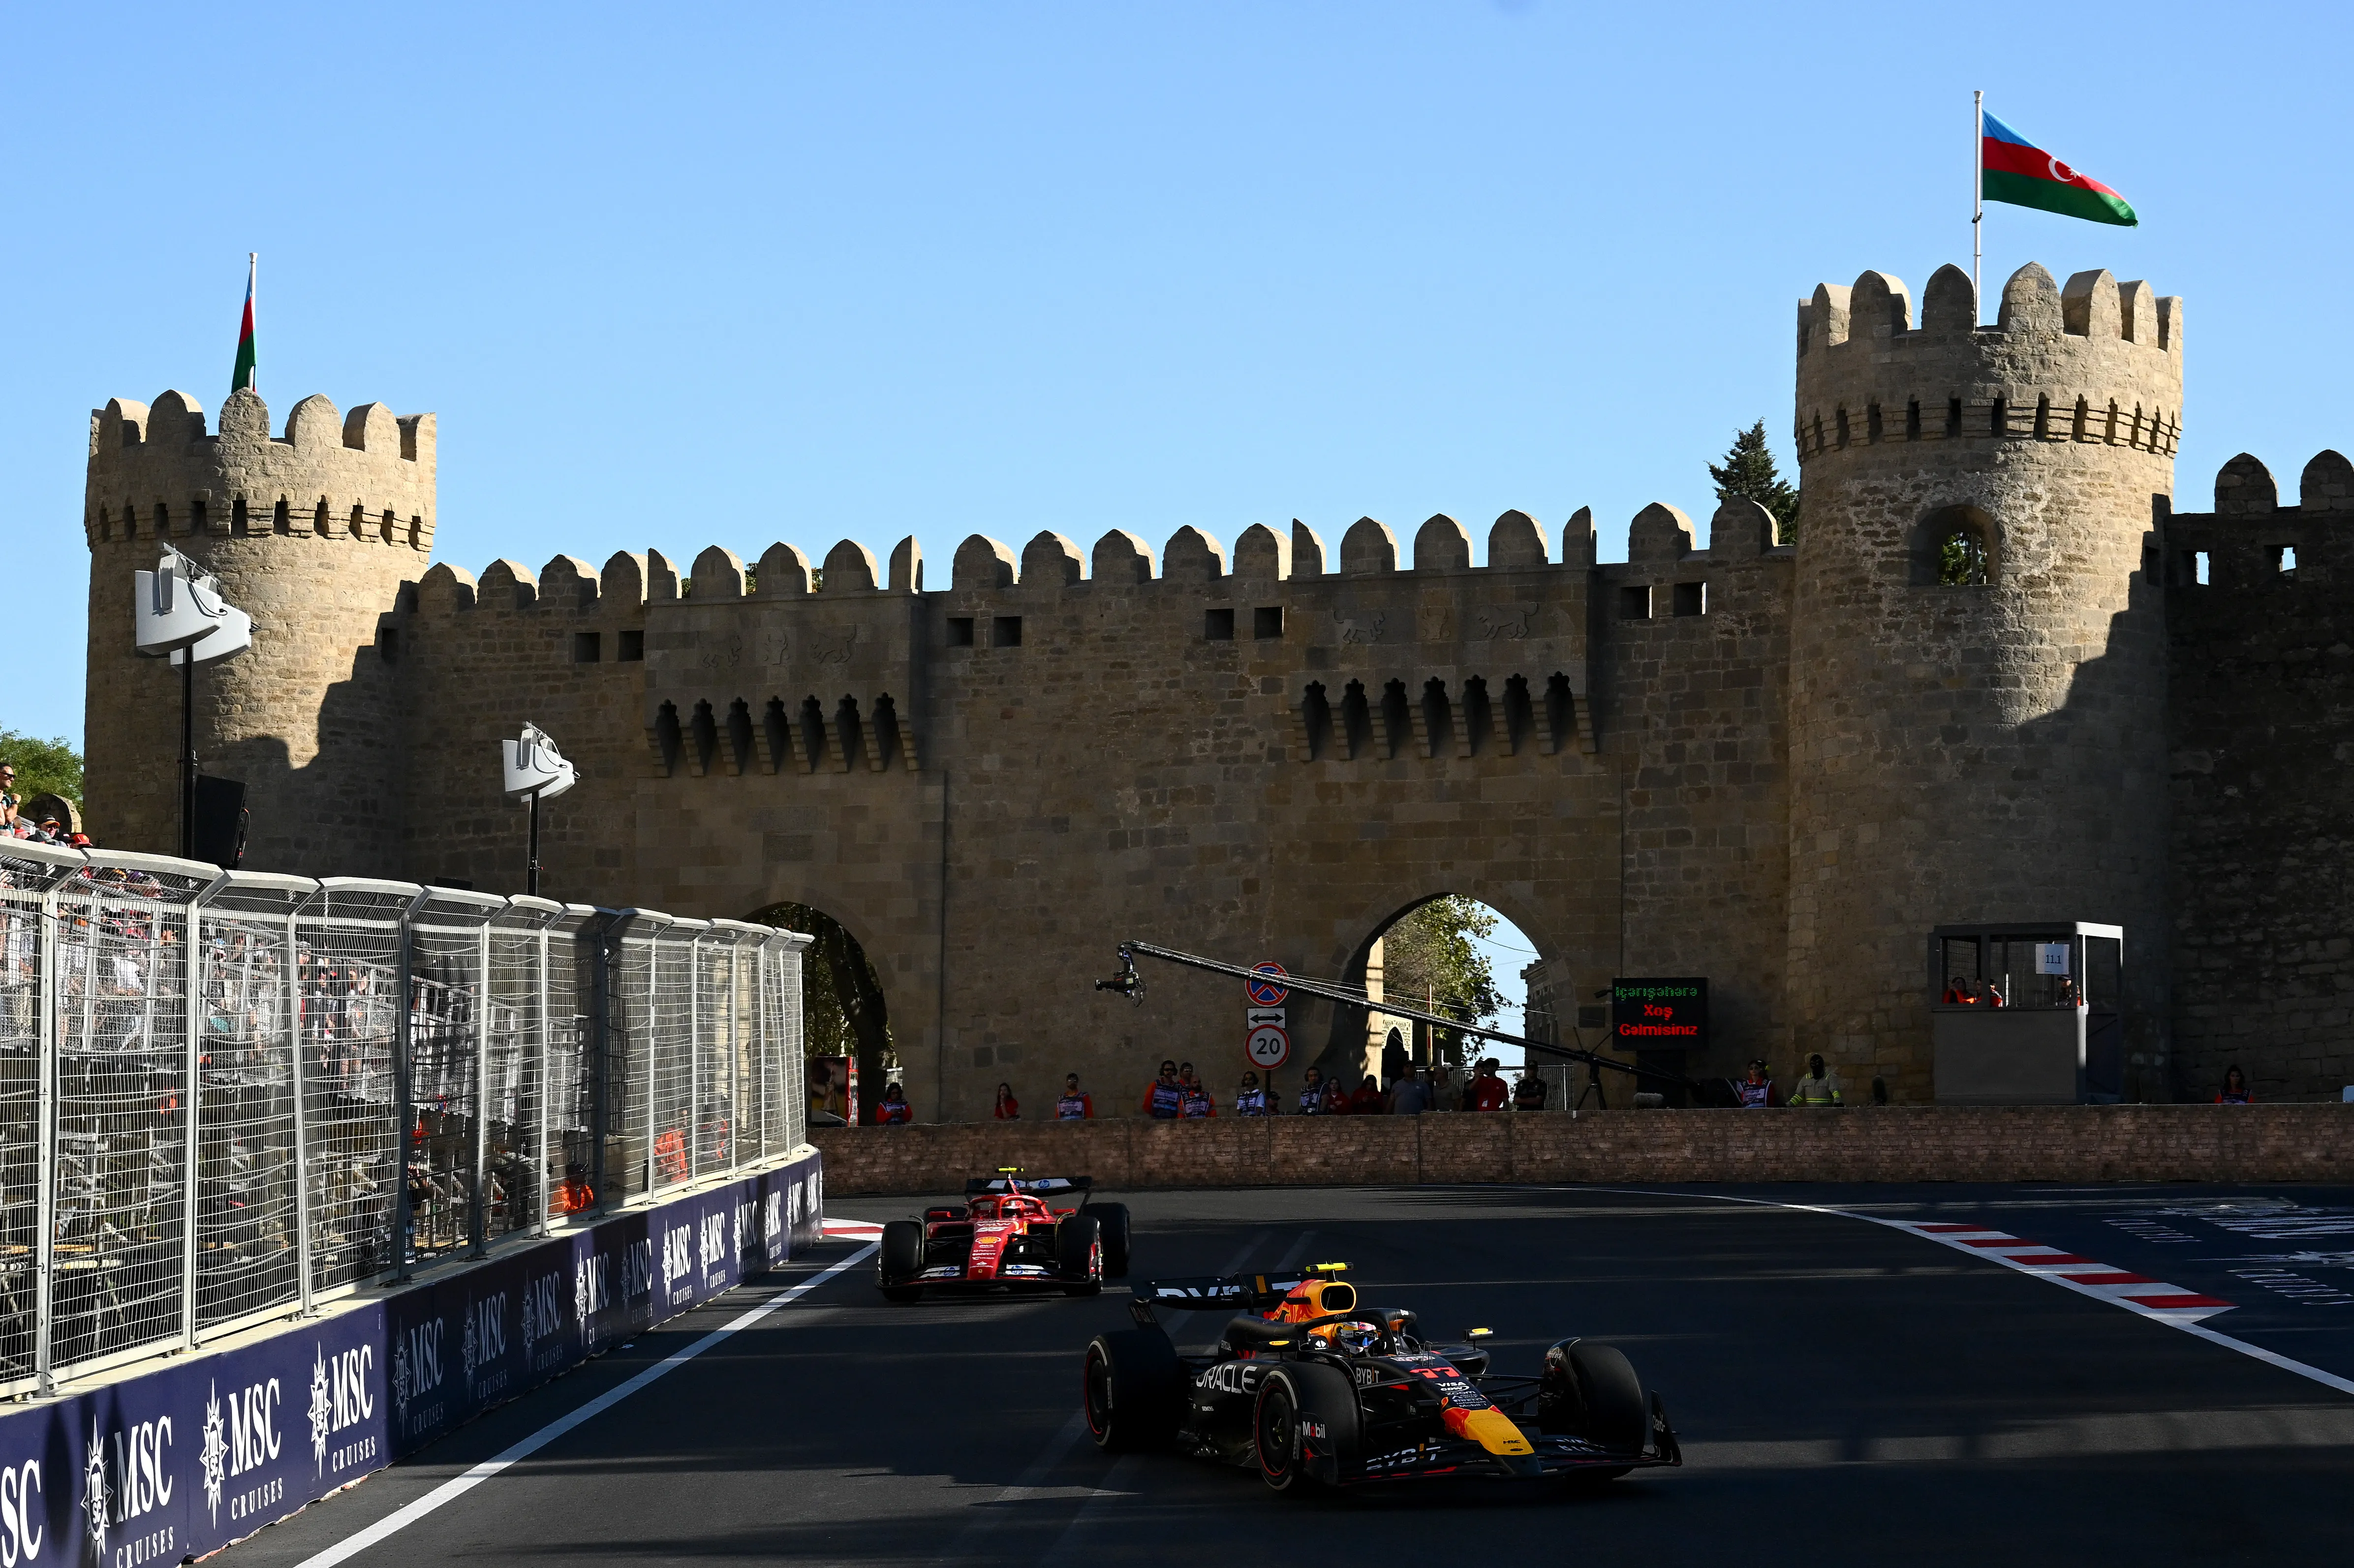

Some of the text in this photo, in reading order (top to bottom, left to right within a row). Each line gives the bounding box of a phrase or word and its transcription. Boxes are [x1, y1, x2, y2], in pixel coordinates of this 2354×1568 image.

[2045, 954, 2061, 964] 11.1
[1644, 1004, 1673, 1020] Xoş
[1256, 1038, 1280, 1054] 20
[708, 1211, 725, 1263] MSC
[741, 1200, 758, 1249] MSC
[630, 1238, 652, 1296] MSC
[672, 1224, 691, 1279] MSC
[535, 1271, 561, 1339] MSC
[587, 1252, 610, 1315] MSC
[478, 1291, 506, 1365] MSC
[411, 1317, 444, 1398] MSC
[1196, 1364, 1259, 1394] ORACLE
[1356, 1366, 1380, 1384] BYBIT
[1409, 1366, 1460, 1379] 11
[332, 1344, 373, 1432] MSC
[229, 1378, 281, 1476] MSC
[413, 1401, 444, 1435] CRUISES
[1302, 1421, 1326, 1439] Mobil
[114, 1415, 172, 1523] MSC
[332, 1436, 376, 1473] CRUISES
[0, 1459, 42, 1568] SC
[231, 1477, 283, 1520] CRUISES
[117, 1526, 173, 1568] CRUISES
